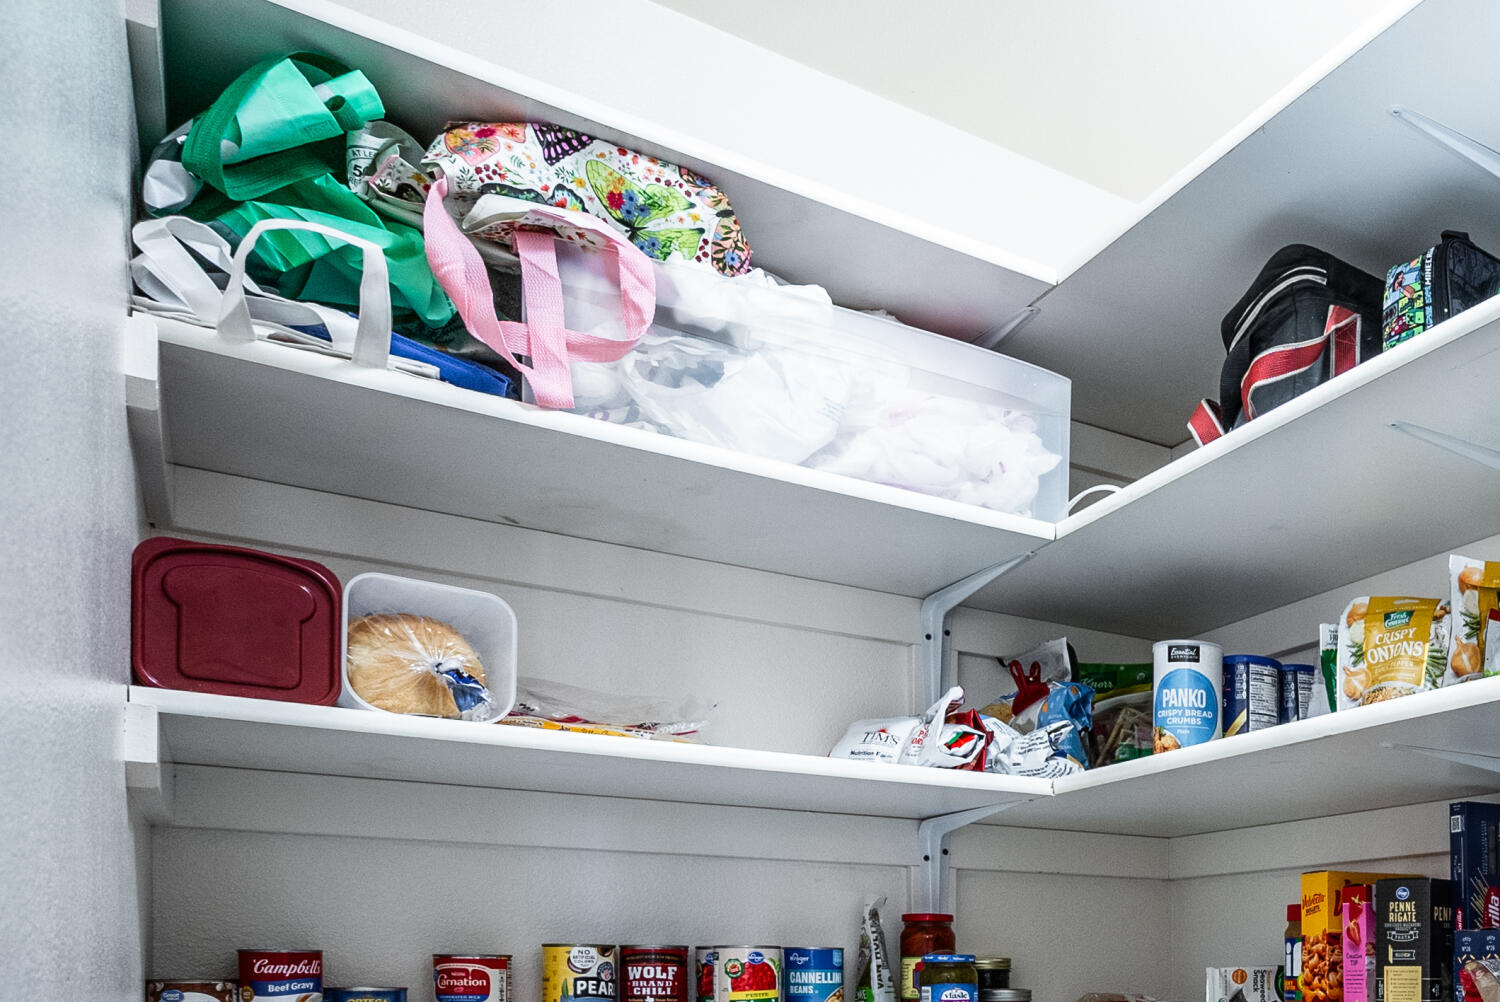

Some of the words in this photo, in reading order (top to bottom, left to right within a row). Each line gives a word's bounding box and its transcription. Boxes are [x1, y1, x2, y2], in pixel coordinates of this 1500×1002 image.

[1375, 628, 1416, 644] CRISPY
[1171, 648, 1197, 656] Essential
[1367, 641, 1424, 664] ONIONS
[1080, 676, 1113, 689] Knorr
[1162, 689, 1206, 708] PANKO
[1158, 710, 1182, 718] CRISPY
[1185, 710, 1212, 718] BREAD
[1166, 717, 1202, 725] CRUMBS
[1389, 901, 1416, 912] PENNE
[1389, 912, 1417, 922] RIGATE
[790, 953, 809, 964] Kroger
[628, 966, 678, 979] WOLF
[790, 972, 843, 984] CANNELLINI
[437, 974, 486, 988] Carnation
[268, 983, 289, 993] Beef
[291, 981, 313, 991] Gravy
[633, 987, 671, 995] CHILI
[790, 985, 814, 994] BEANS
